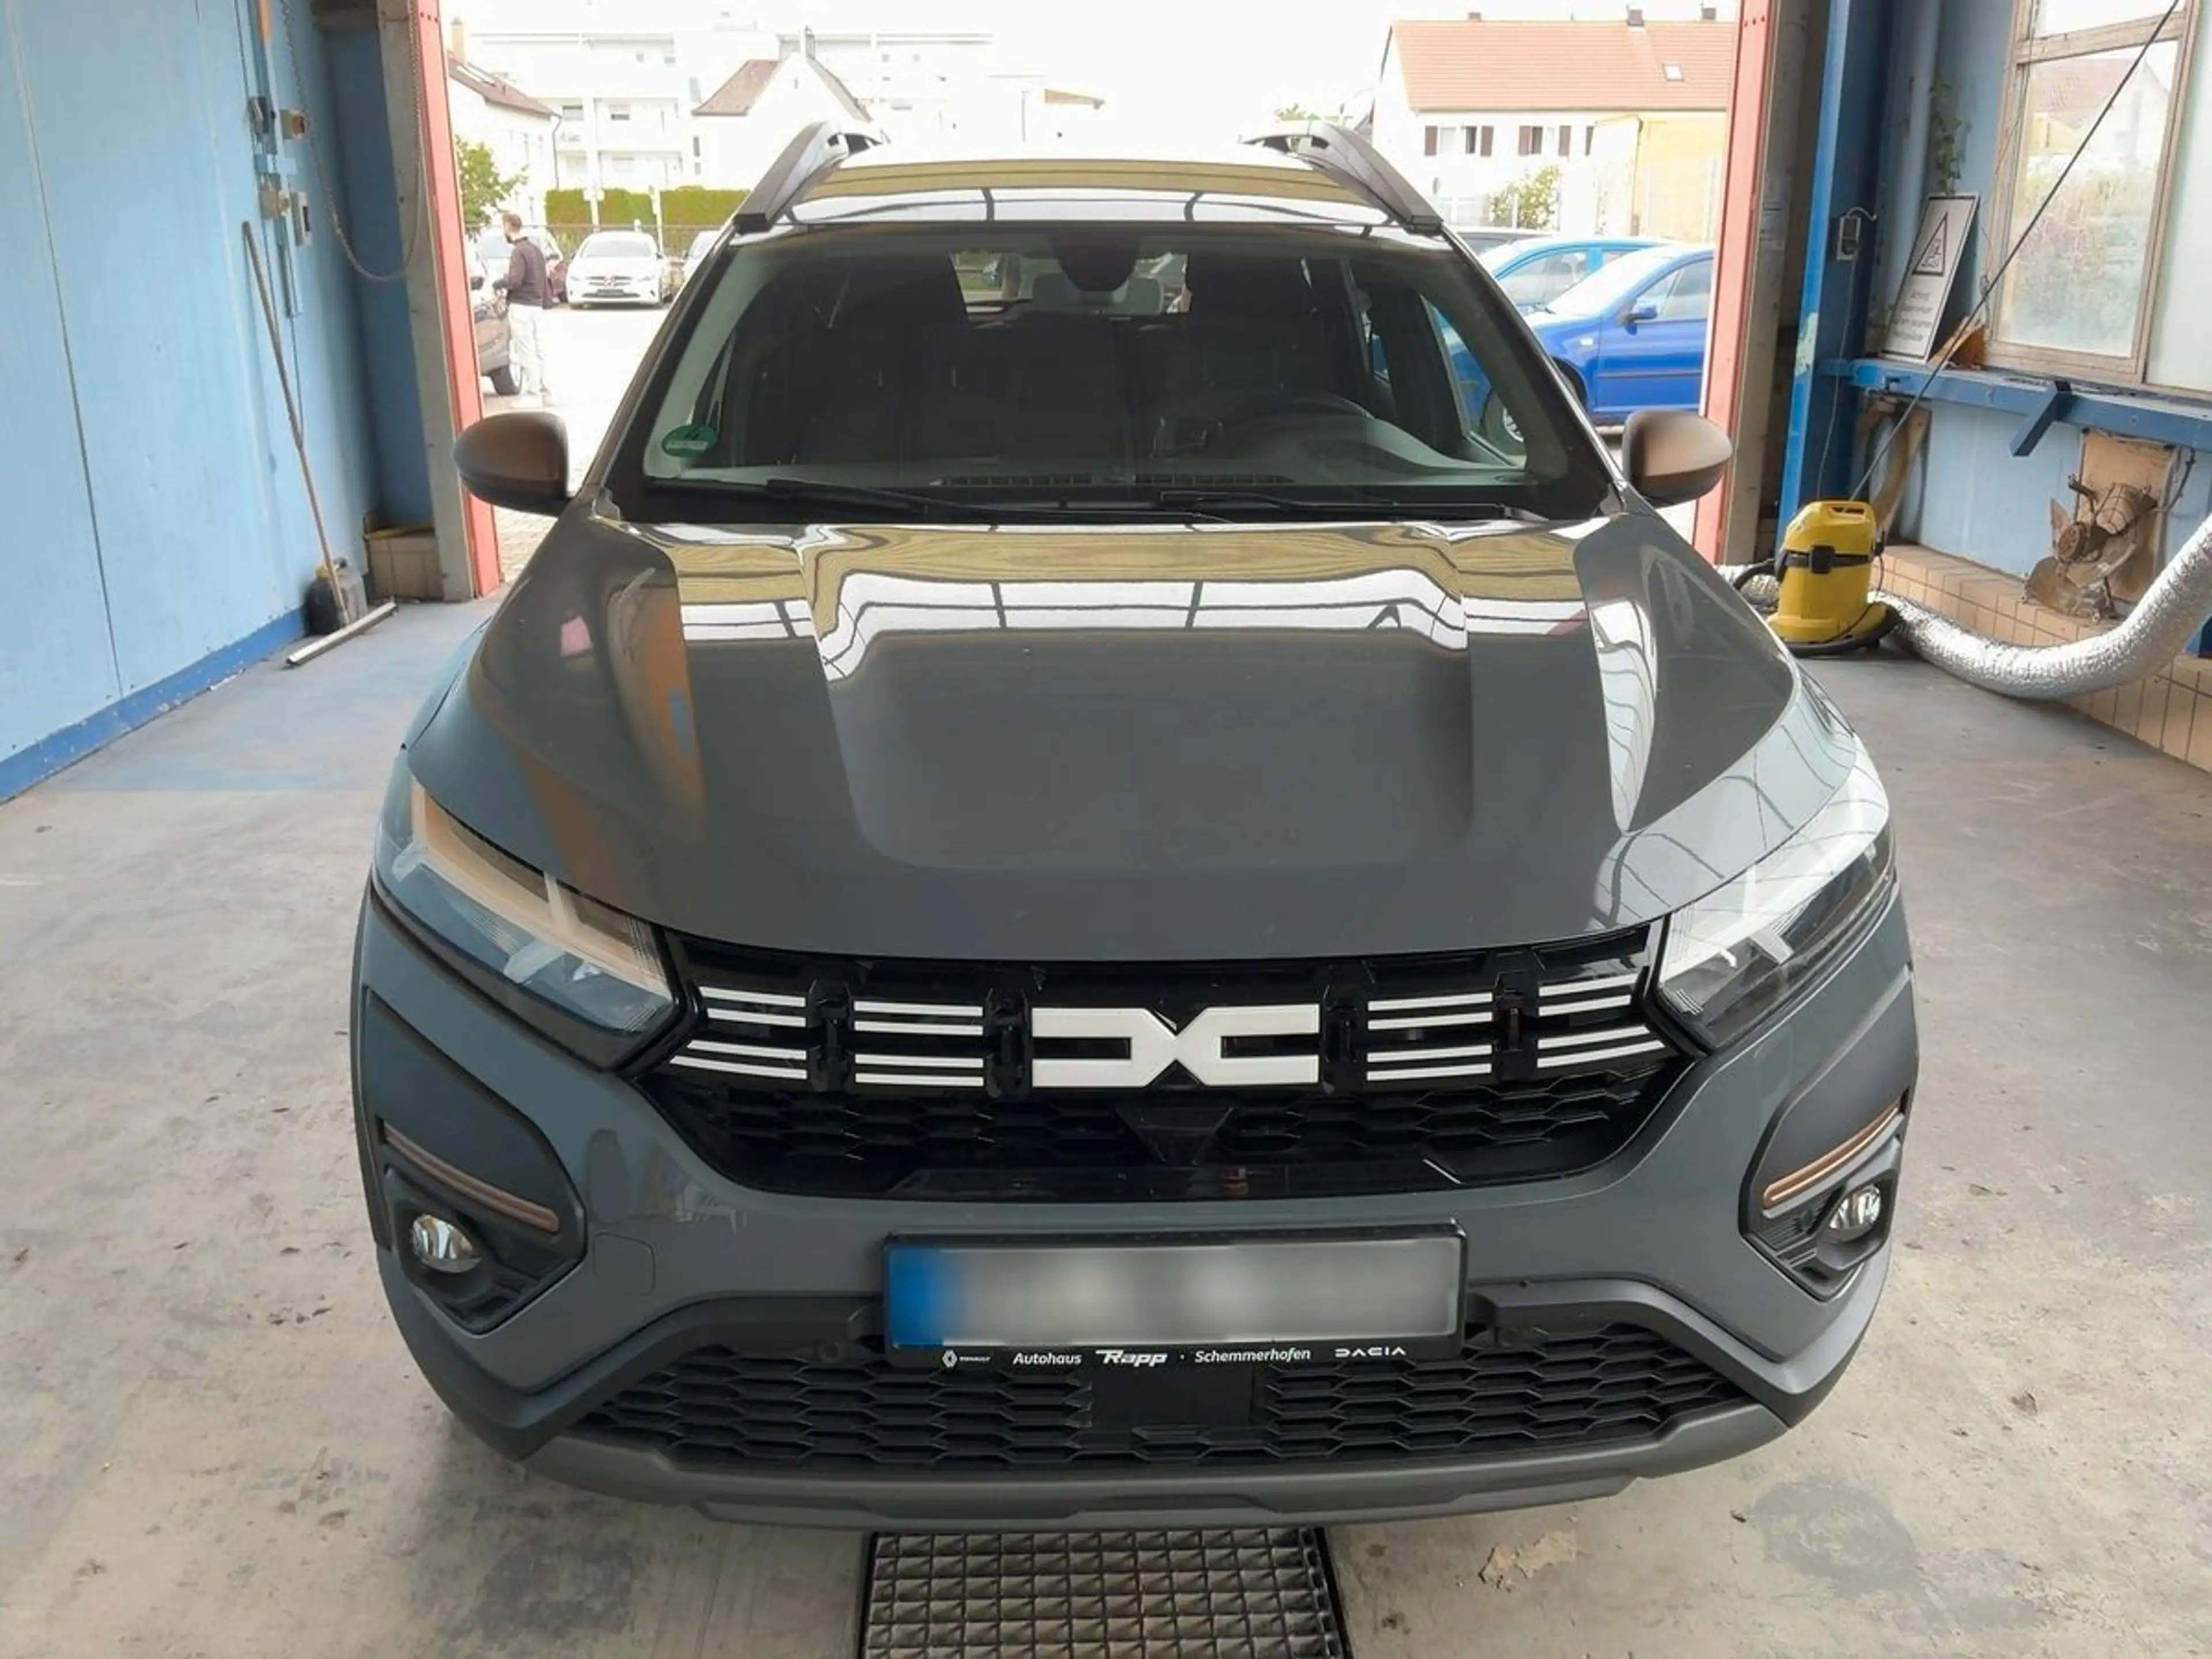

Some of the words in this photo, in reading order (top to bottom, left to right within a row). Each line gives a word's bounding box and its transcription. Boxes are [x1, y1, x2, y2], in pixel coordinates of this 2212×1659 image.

[1012, 1352, 1082, 1365] Autohaus
[1094, 1349, 1168, 1368] Rapp
[1194, 1347, 1312, 1363] Schemmerhofen
[1335, 1346, 1406, 1358] DACIA
